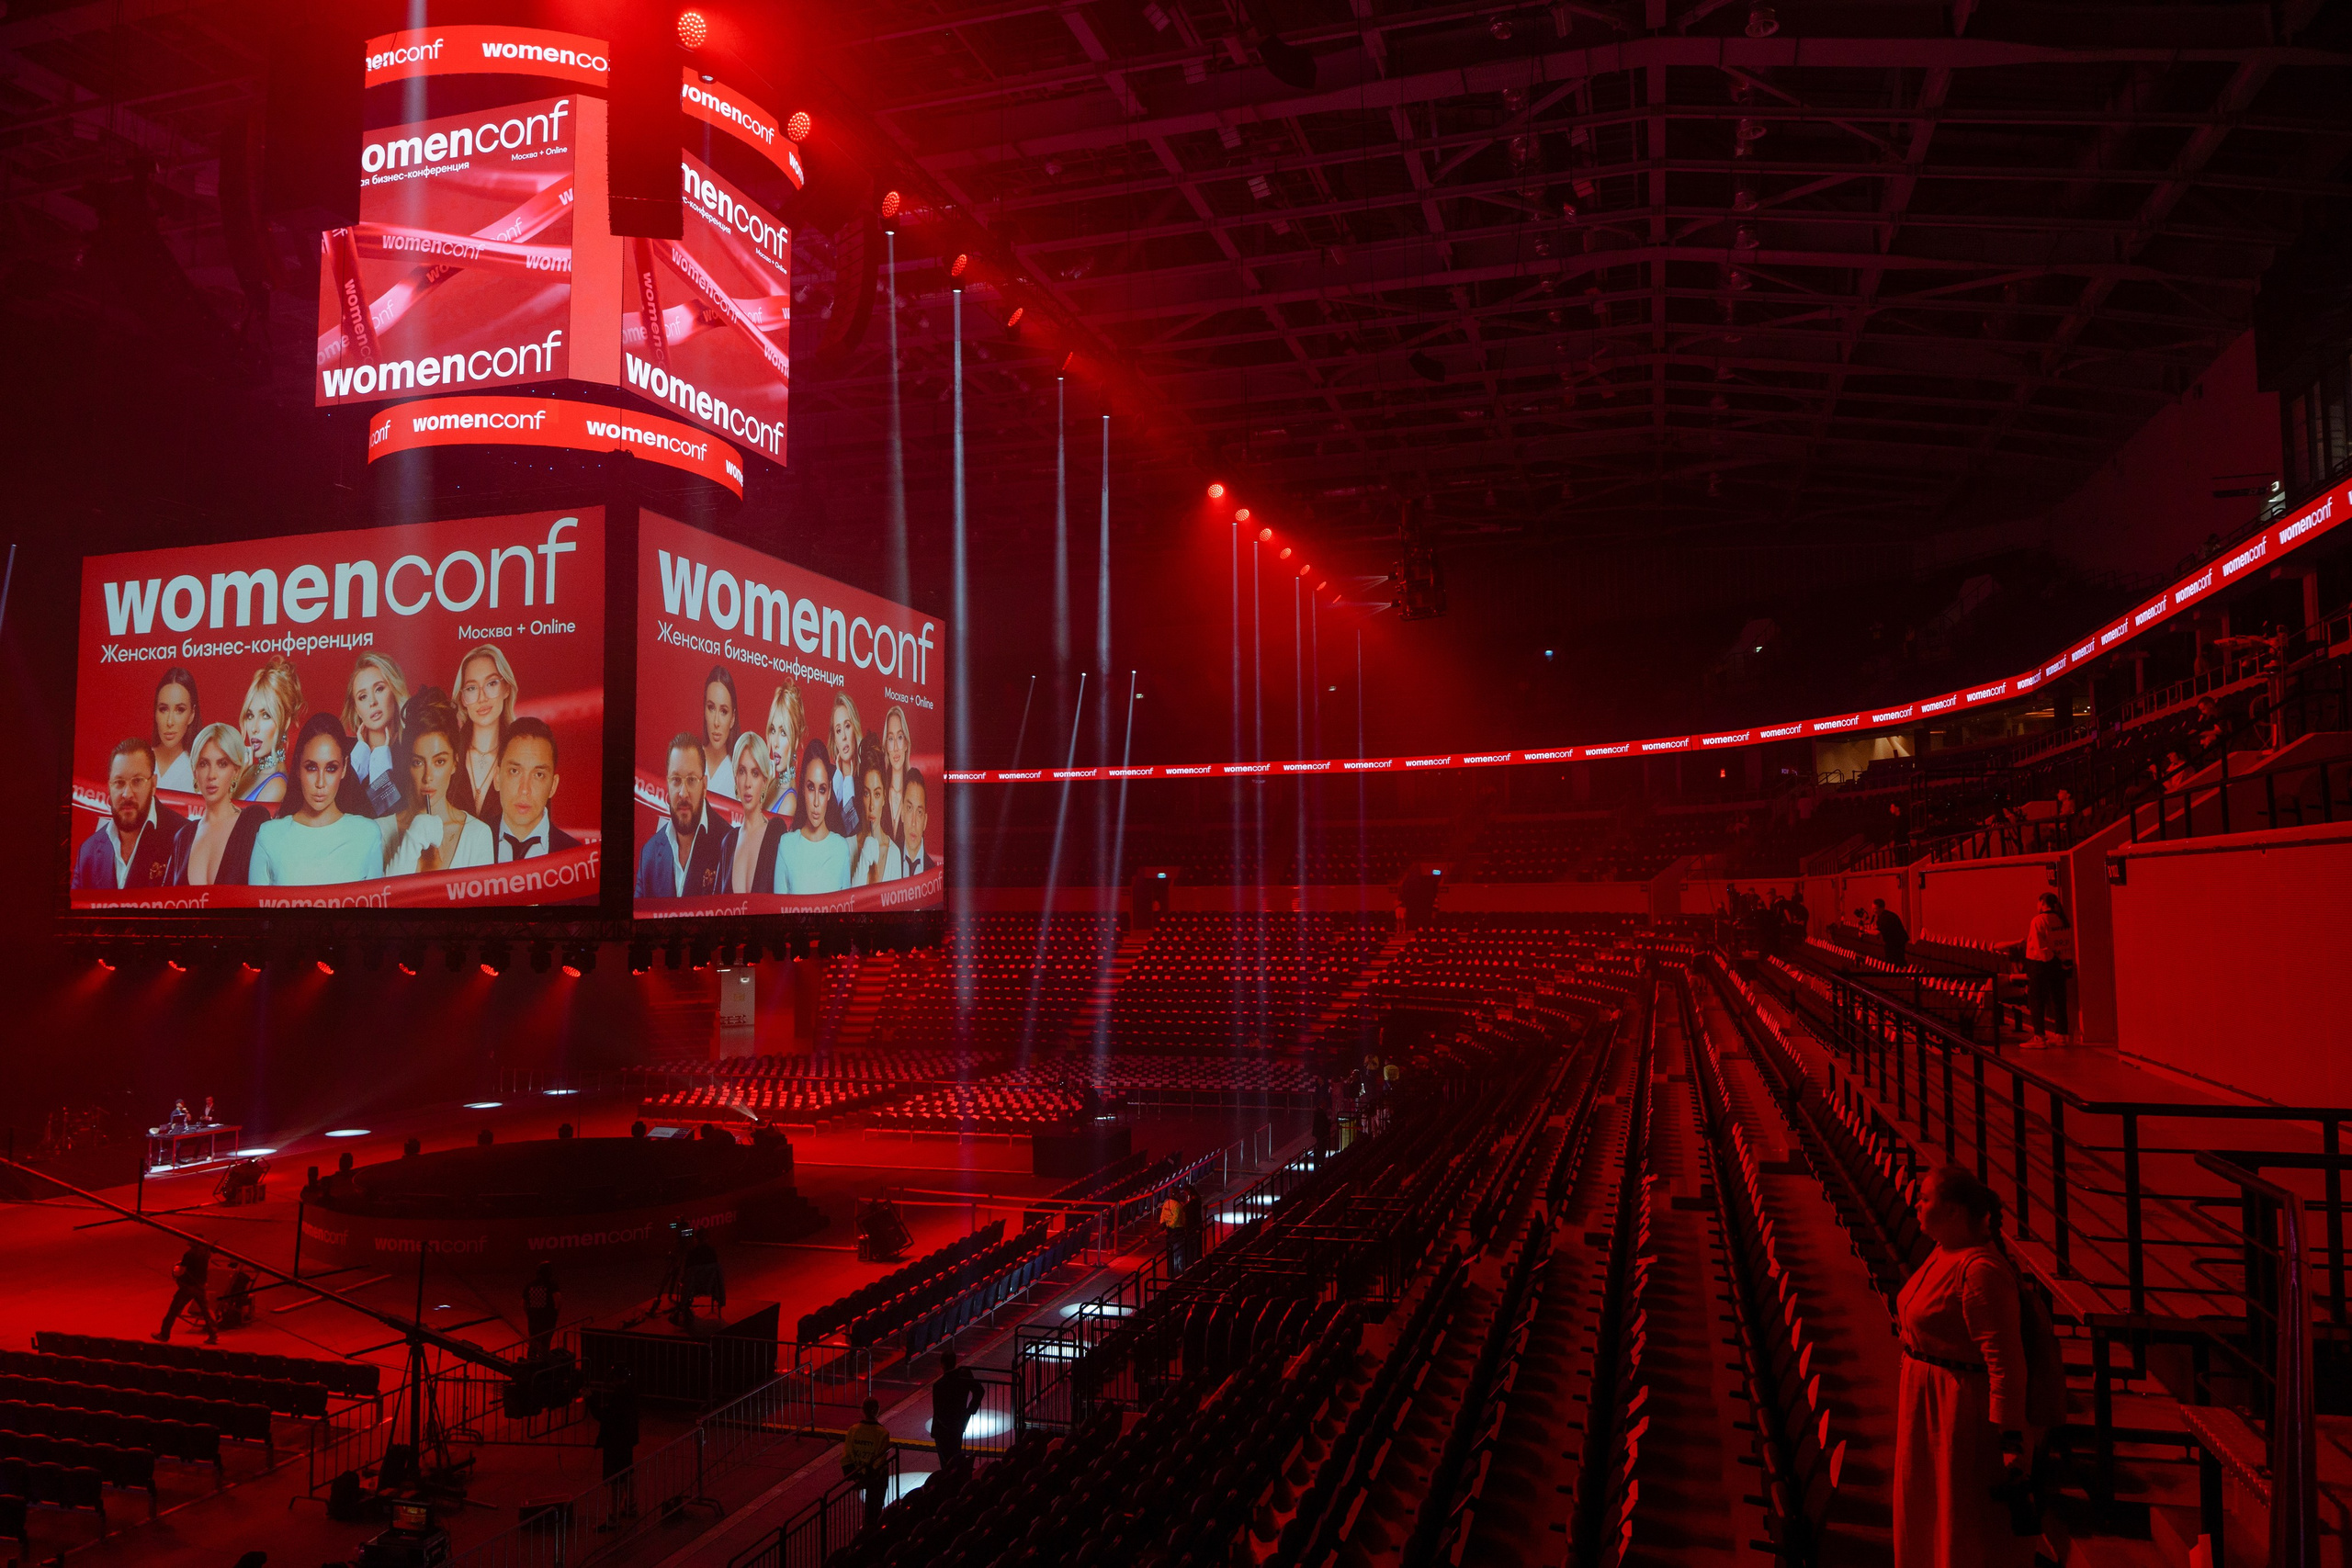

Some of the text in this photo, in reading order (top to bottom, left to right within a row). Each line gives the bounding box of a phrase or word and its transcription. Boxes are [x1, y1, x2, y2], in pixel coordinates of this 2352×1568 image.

[366, 39, 610, 72] enconf womenco
[361, 99, 570, 173] omenconf
[511, 152, 538, 162] Москва
[546, 146, 568, 156] Online
[371, 162, 469, 185] бизнес-конференция
[682, 162, 788, 260] menconf
[683, 196, 731, 235] с-конференция
[382, 234, 486, 260] womenconf
[322, 330, 562, 398] womenconf
[626, 352, 785, 456] womenconf
[413, 411, 547, 433] womenconf
[586, 420, 708, 461] womenconf
[103, 517, 579, 636] womenconf
[458, 625, 513, 640] Москва
[530, 618, 576, 636] Online
[658, 549, 934, 685] womenconf
[998, 770, 1043, 780] womenconf
[1053, 768, 1098, 779] womenconf
[1108, 767, 1154, 777] womenconf
[1165, 765, 1212, 775] womenconf
[1223, 762, 1272, 773] womenconf
[1283, 761, 1331, 772] womenconf
[1343, 759, 1393, 770] womenconf
[1405, 756, 1452, 767] womenconf
[1463, 752, 1511, 764] womenconf
[1523, 748, 1574, 761] womenconf
[1585, 742, 1630, 756] womenconf
[1641, 738, 1690, 751] womenconf
[1702, 730, 1750, 746] womenconf
[1759, 723, 1803, 739] womenconf
[1813, 715, 1860, 731] womenconf
[1871, 705, 1914, 723] womenconf
[1920, 694, 1957, 714] womenconf
[1966, 682, 2007, 703] womenconf
[2071, 637, 2096, 663] womenconf
[2100, 617, 2129, 646] womenconf
[2134, 594, 2167, 626] womenconf
[2175, 568, 2213, 604] womenconf
[2222, 535, 2267, 578] womenconf
[2278, 496, 2334, 545] womenconf
[100, 631, 374, 663] Женская бизнес-конференция
[658, 620, 844, 687] Женская бизнес-конференция
[884, 686, 909, 705] Москва
[915, 694, 933, 710] Online
[446, 851, 599, 901] womenconf
[881, 871, 943, 907] womenconf
[301, 1220, 349, 1247] omenconf
[374, 1235, 489, 1253] womenconf
[527, 1221, 653, 1251] womenconf
